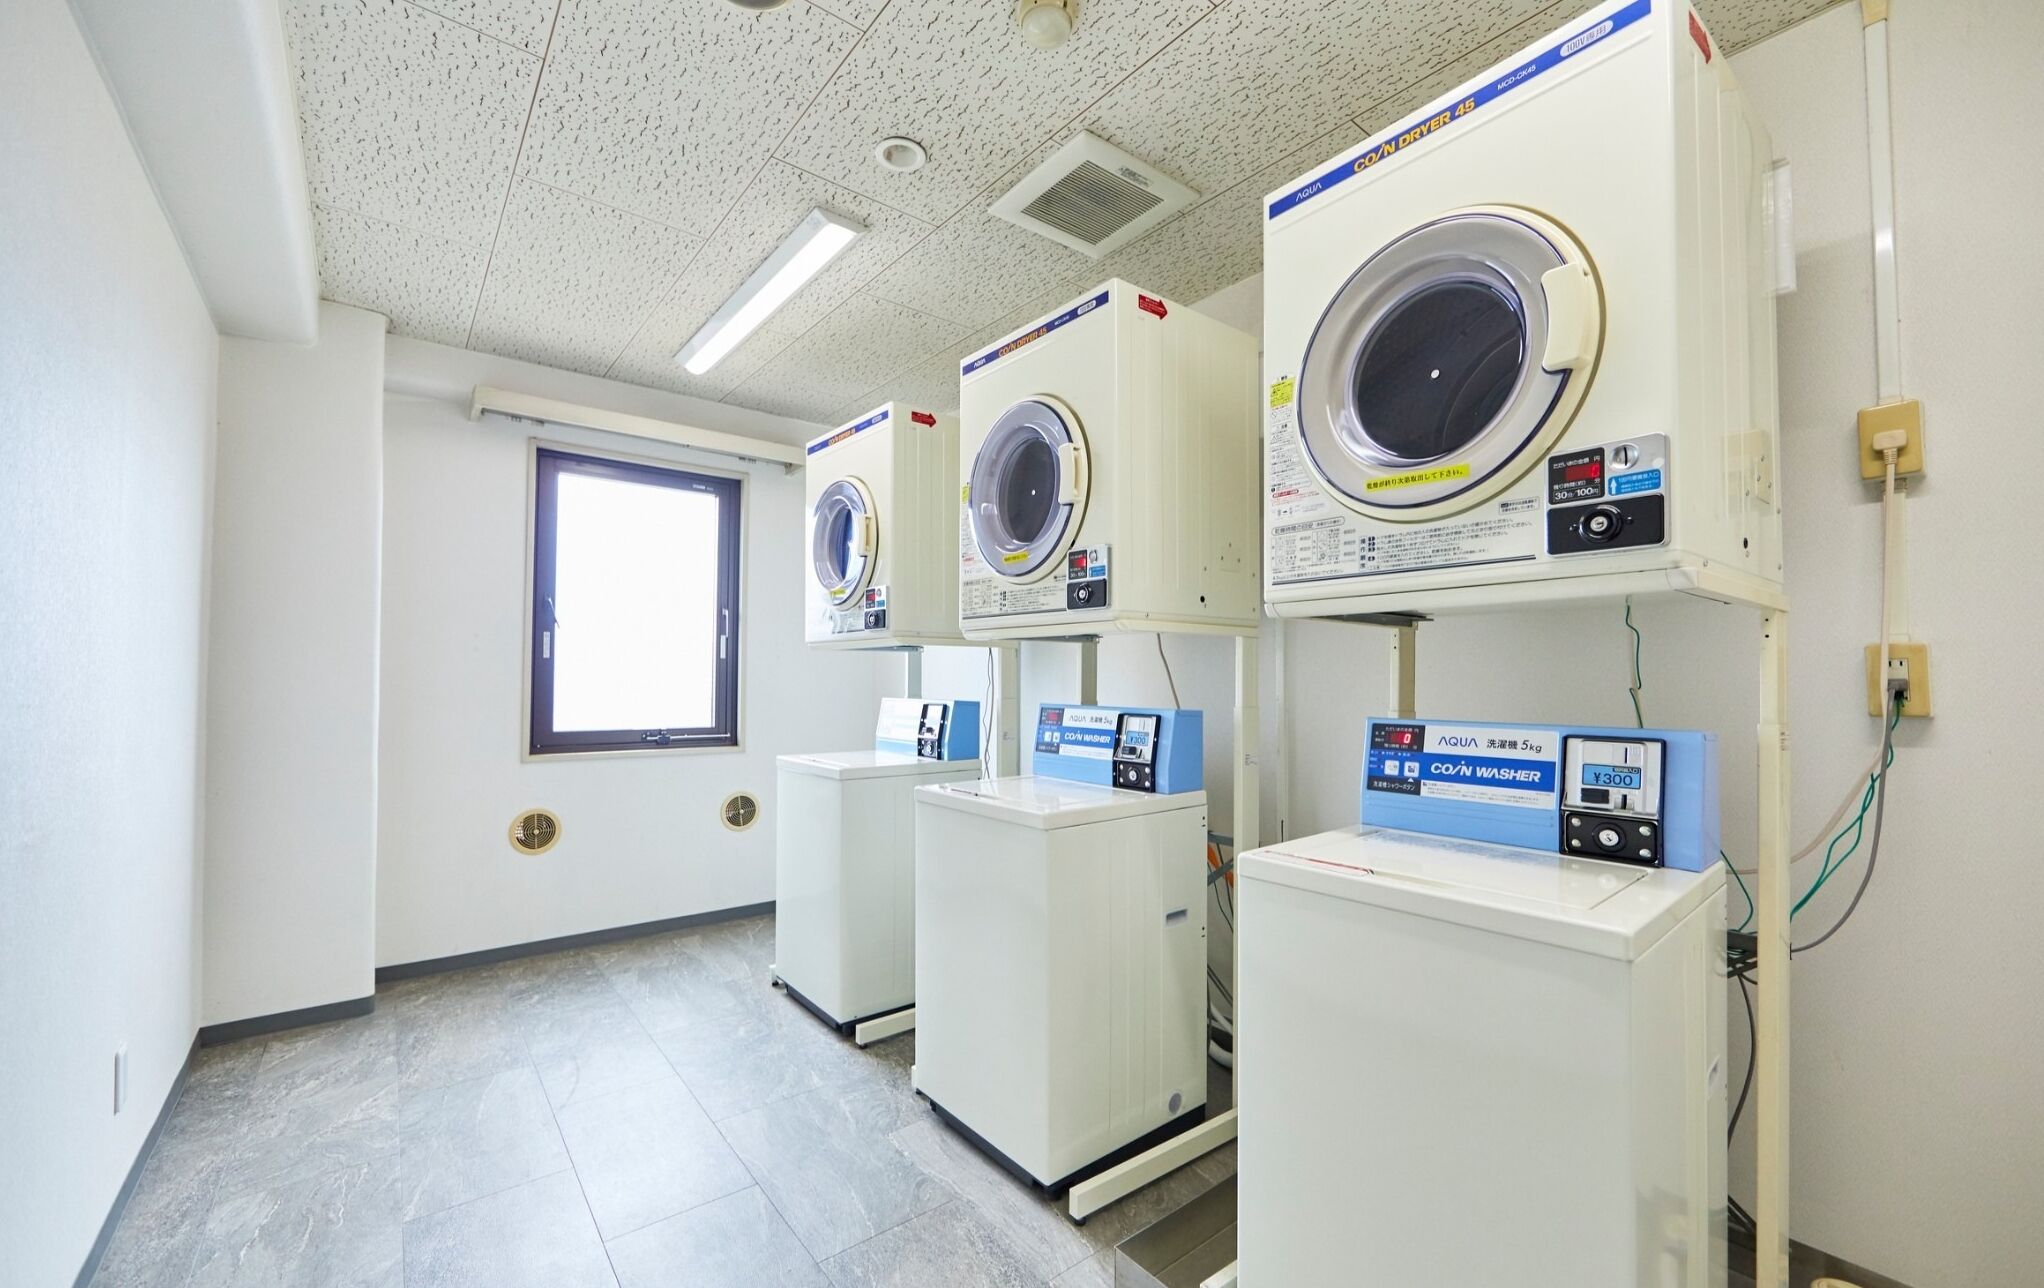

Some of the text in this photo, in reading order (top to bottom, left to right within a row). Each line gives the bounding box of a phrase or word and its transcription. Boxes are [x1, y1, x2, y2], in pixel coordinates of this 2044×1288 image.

[1295, 182, 1323, 202] AQUA
[1398, 111, 1452, 148] DRYER
[1454, 98, 1476, 118] 45
[1497, 64, 1537, 91] MCD-CK45
[1083, 734, 1111, 744] WASHER
[1403, 733, 1412, 744] 0
[1438, 736, 1543, 754] AQUA 洗濯機 5kg
[1430, 760, 1542, 783] COIN WASHER
[1593, 771, 1634, 786] ¥300
